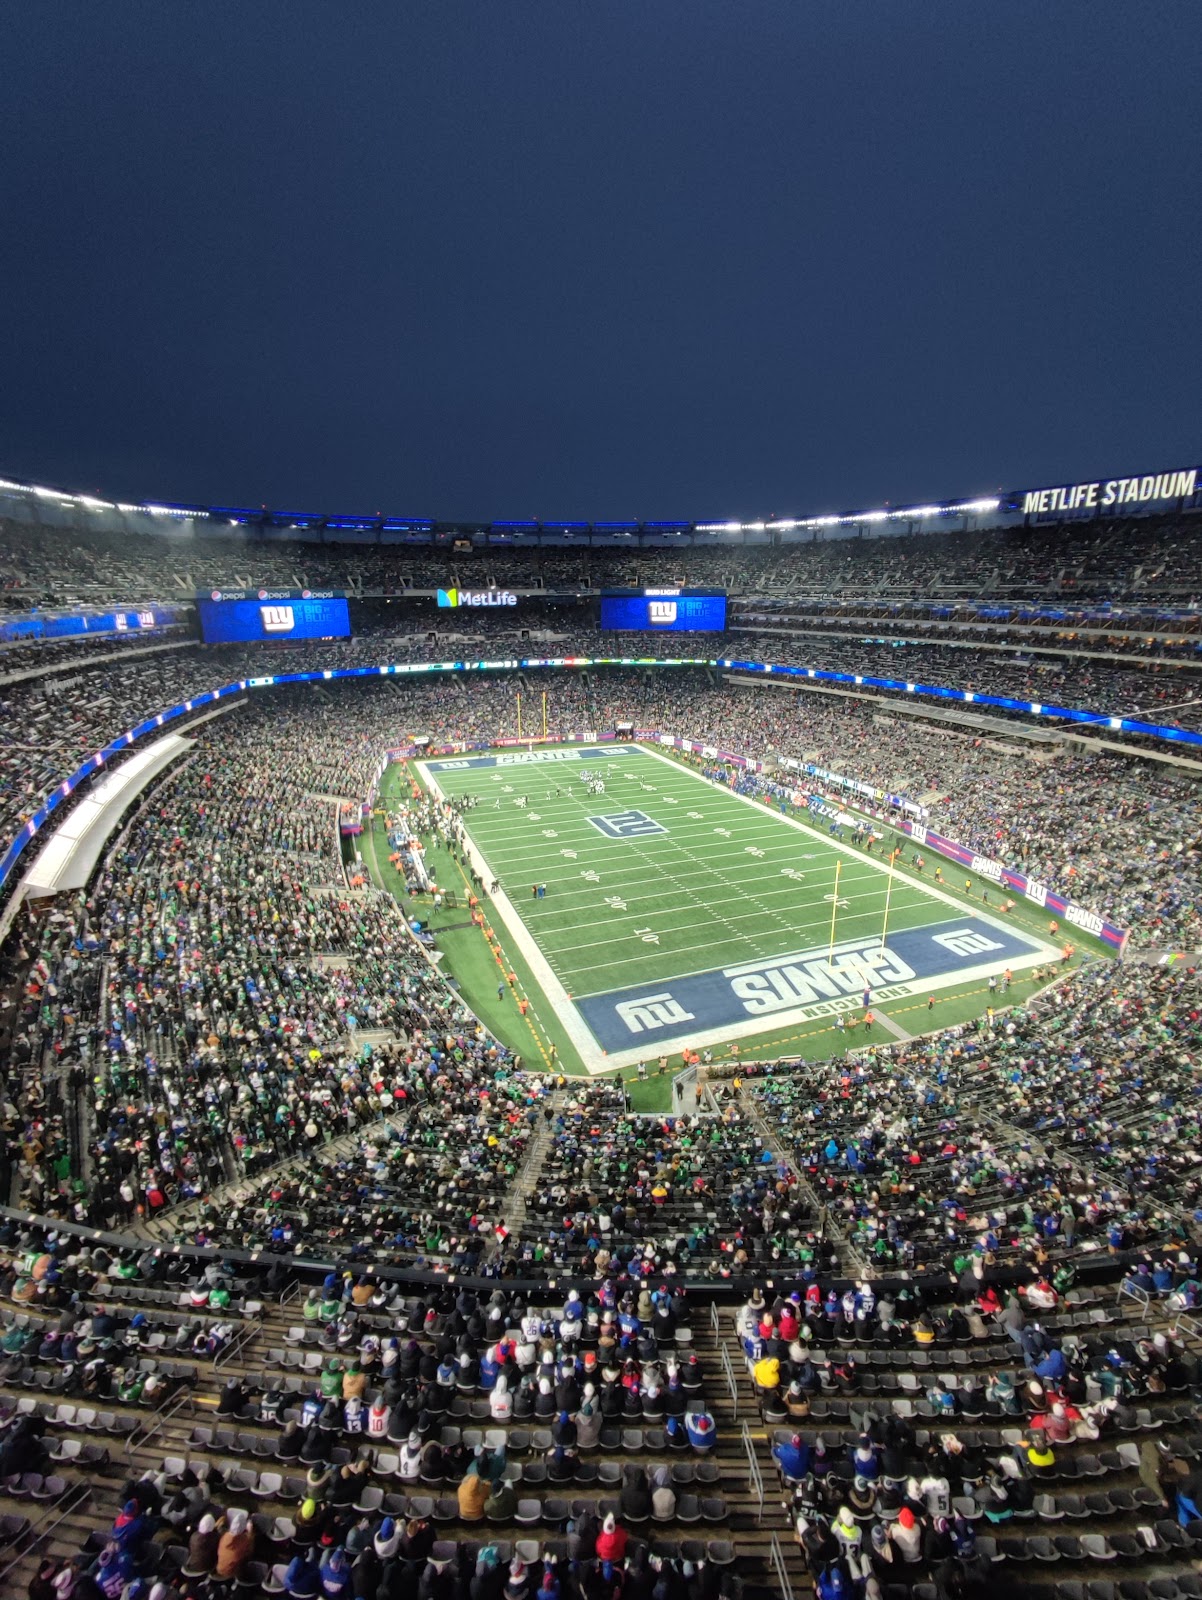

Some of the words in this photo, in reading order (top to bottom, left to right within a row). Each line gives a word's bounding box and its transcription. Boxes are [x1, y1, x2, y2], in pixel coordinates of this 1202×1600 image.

[1024, 483, 1099, 514] METLIFE
[1102, 469, 1197, 505] STADIUM
[222, 591, 245, 600] pepsi
[268, 590, 290, 599] pepsi
[311, 590, 333, 599] pepsi
[457, 591, 517, 606] MetLife
[497, 751, 581, 765] GIANTS
[971, 855, 1002, 880] GIANTS
[1065, 905, 1104, 936] GIANTS
[633, 927, 660, 943] 10
[729, 946, 917, 1015] GIANTS
[876, 985, 913, 999] END
[801, 995, 874, 1018] ACISM
[863, 1301, 874, 1312] 97
[347, 1420, 362, 1432] 13
[373, 1419, 383, 1431] 10
[937, 1495, 946, 1510] 5
